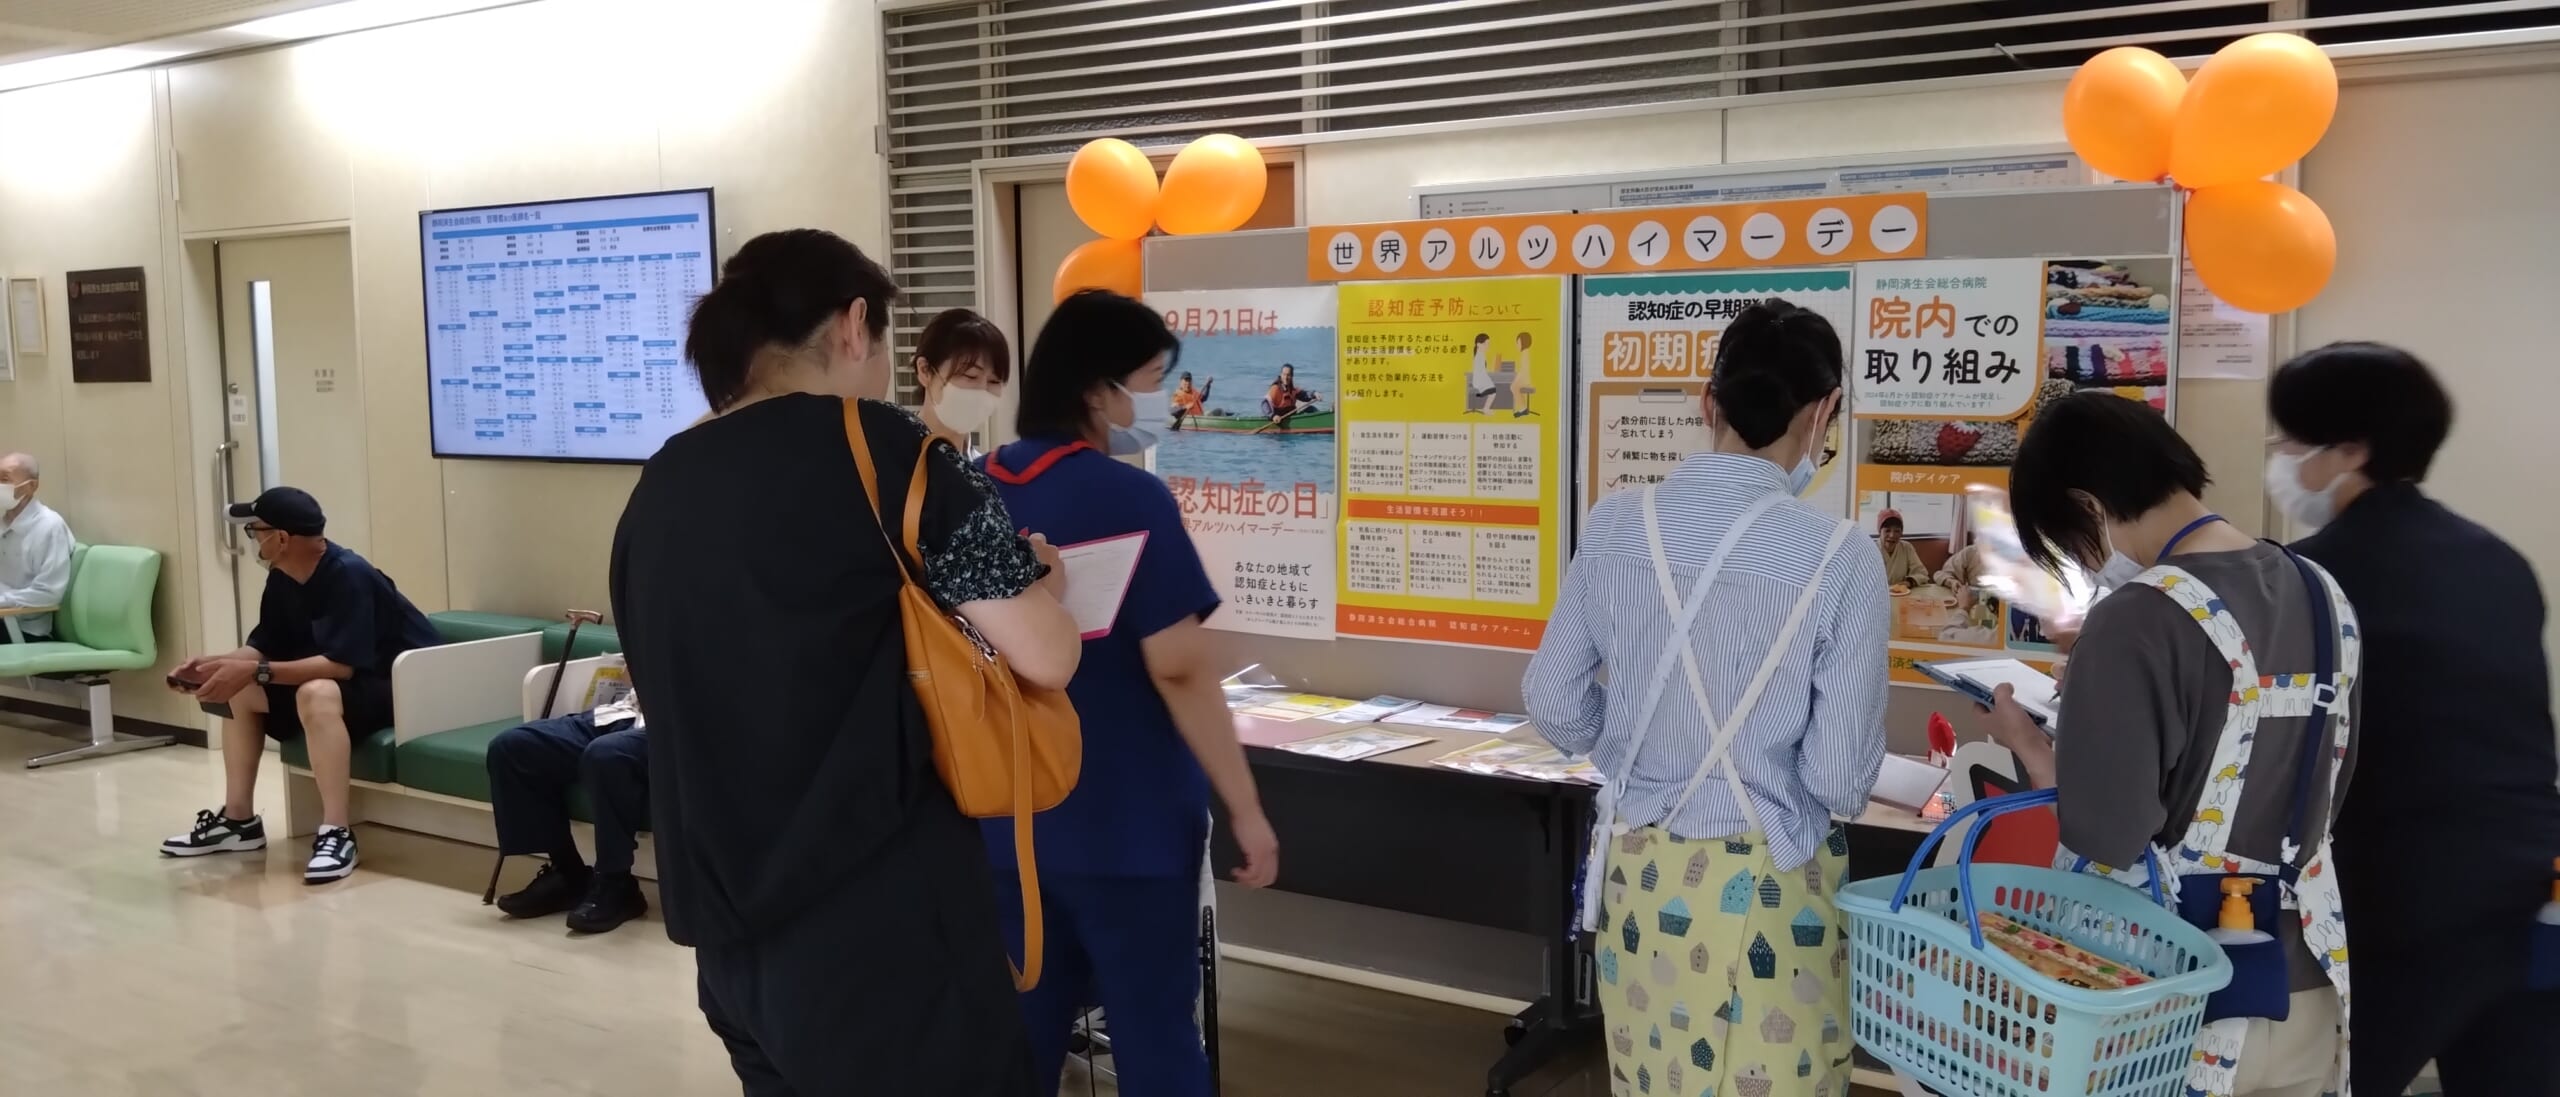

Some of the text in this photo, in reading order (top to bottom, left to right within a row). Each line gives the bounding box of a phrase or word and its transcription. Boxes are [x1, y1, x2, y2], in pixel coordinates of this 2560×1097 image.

[1334, 219, 1907, 266] 世界アルツハイマーデー
[1876, 277, 1988, 290] 静岡済生会総合病院
[1368, 297, 1521, 317] 認知症予防について
[1628, 299, 1768, 321] 認知症の早期
[1165, 308, 1279, 337] 9月21日は
[1864, 348, 2021, 385] 取り組み
[1620, 416, 1703, 427] 数分前に話した内容
[1620, 429, 1674, 438] 忘れてしまう
[1890, 472, 1960, 484] 院内デイケア
[1235, 561, 1312, 577] あなたの地域で
[1235, 576, 1309, 592] 認知症とともに
[1235, 594, 1319, 609] いきいきと暮らす
[1449, 621, 1531, 636] 認知症ケアチーム
